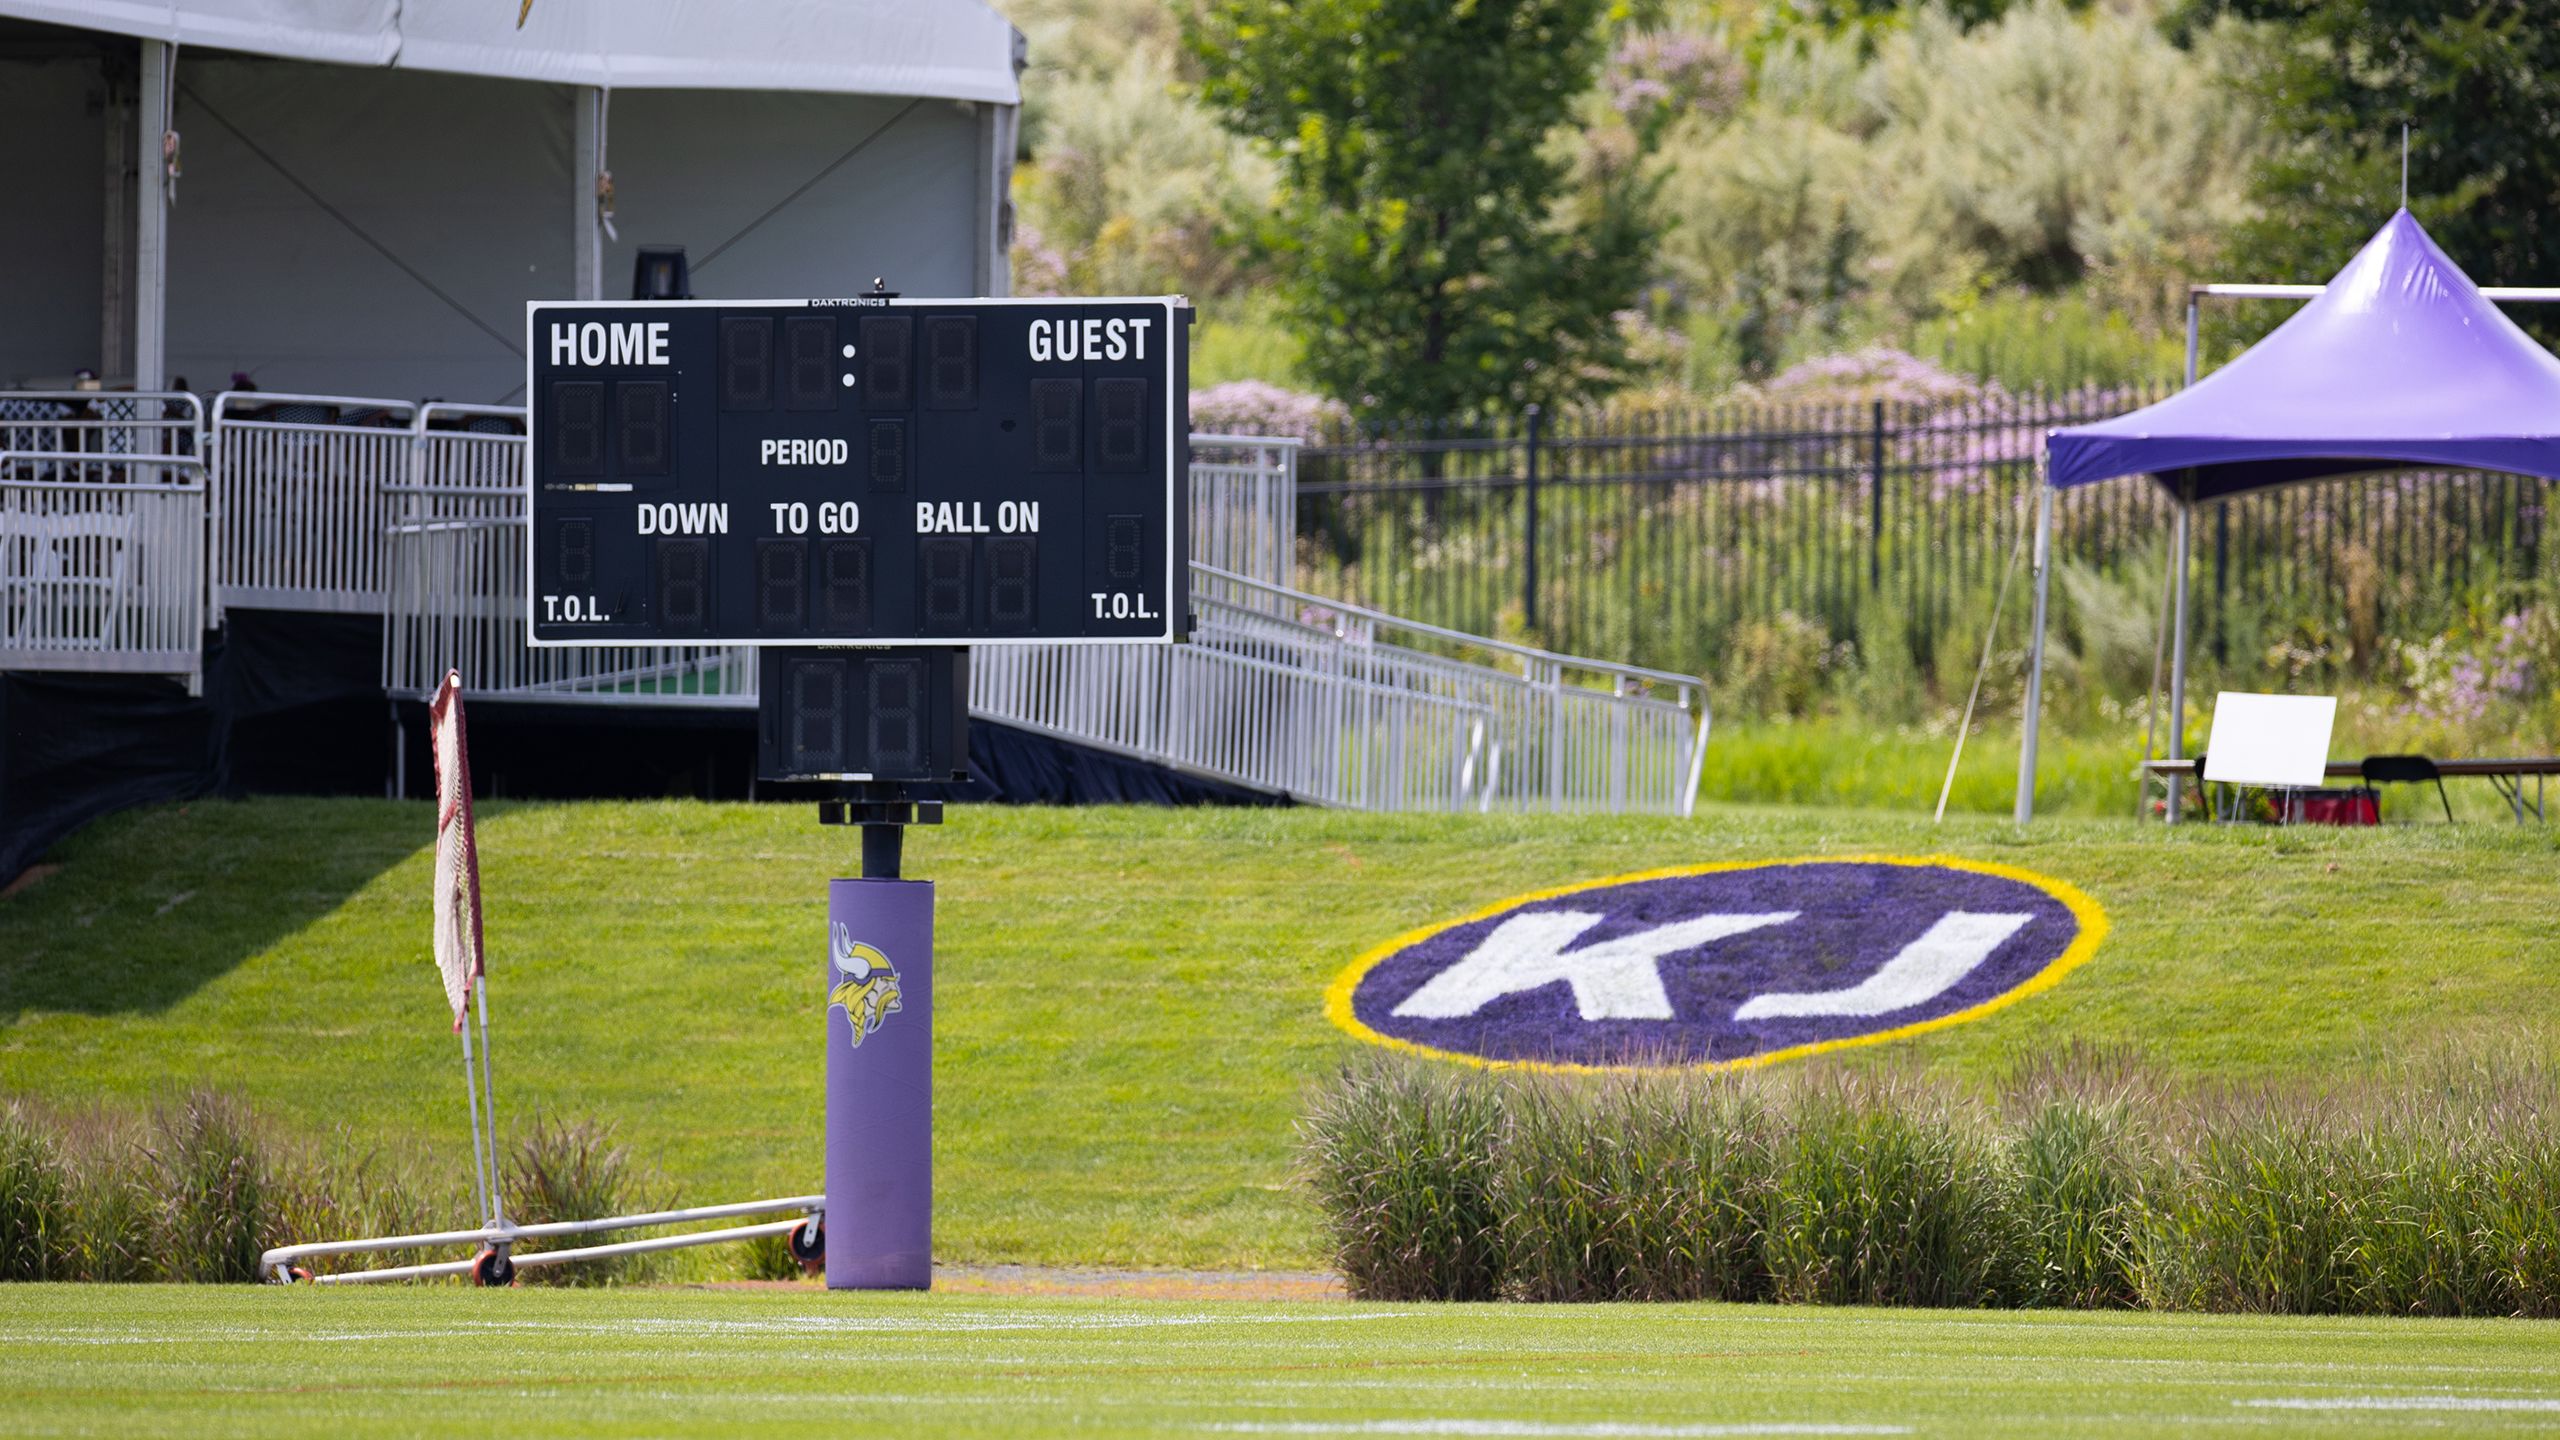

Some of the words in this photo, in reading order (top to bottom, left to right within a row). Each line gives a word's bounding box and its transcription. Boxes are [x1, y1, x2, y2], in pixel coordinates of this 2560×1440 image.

[811, 298, 886, 307] DAKTRONICS
[551, 322, 669, 366] HOME
[1028, 318, 1152, 362] GUEST
[761, 438, 848, 466] PERIOD
[638, 502, 728, 535] DOWN
[770, 502, 809, 535] TO
[818, 501, 859, 534] GO
[916, 501, 990, 533] BALL
[998, 500, 1039, 534] ON
[543, 595, 610, 622] T.O.L.
[1091, 592, 1159, 619] T.O.L.
[1390, 908, 2035, 1022] KJ
